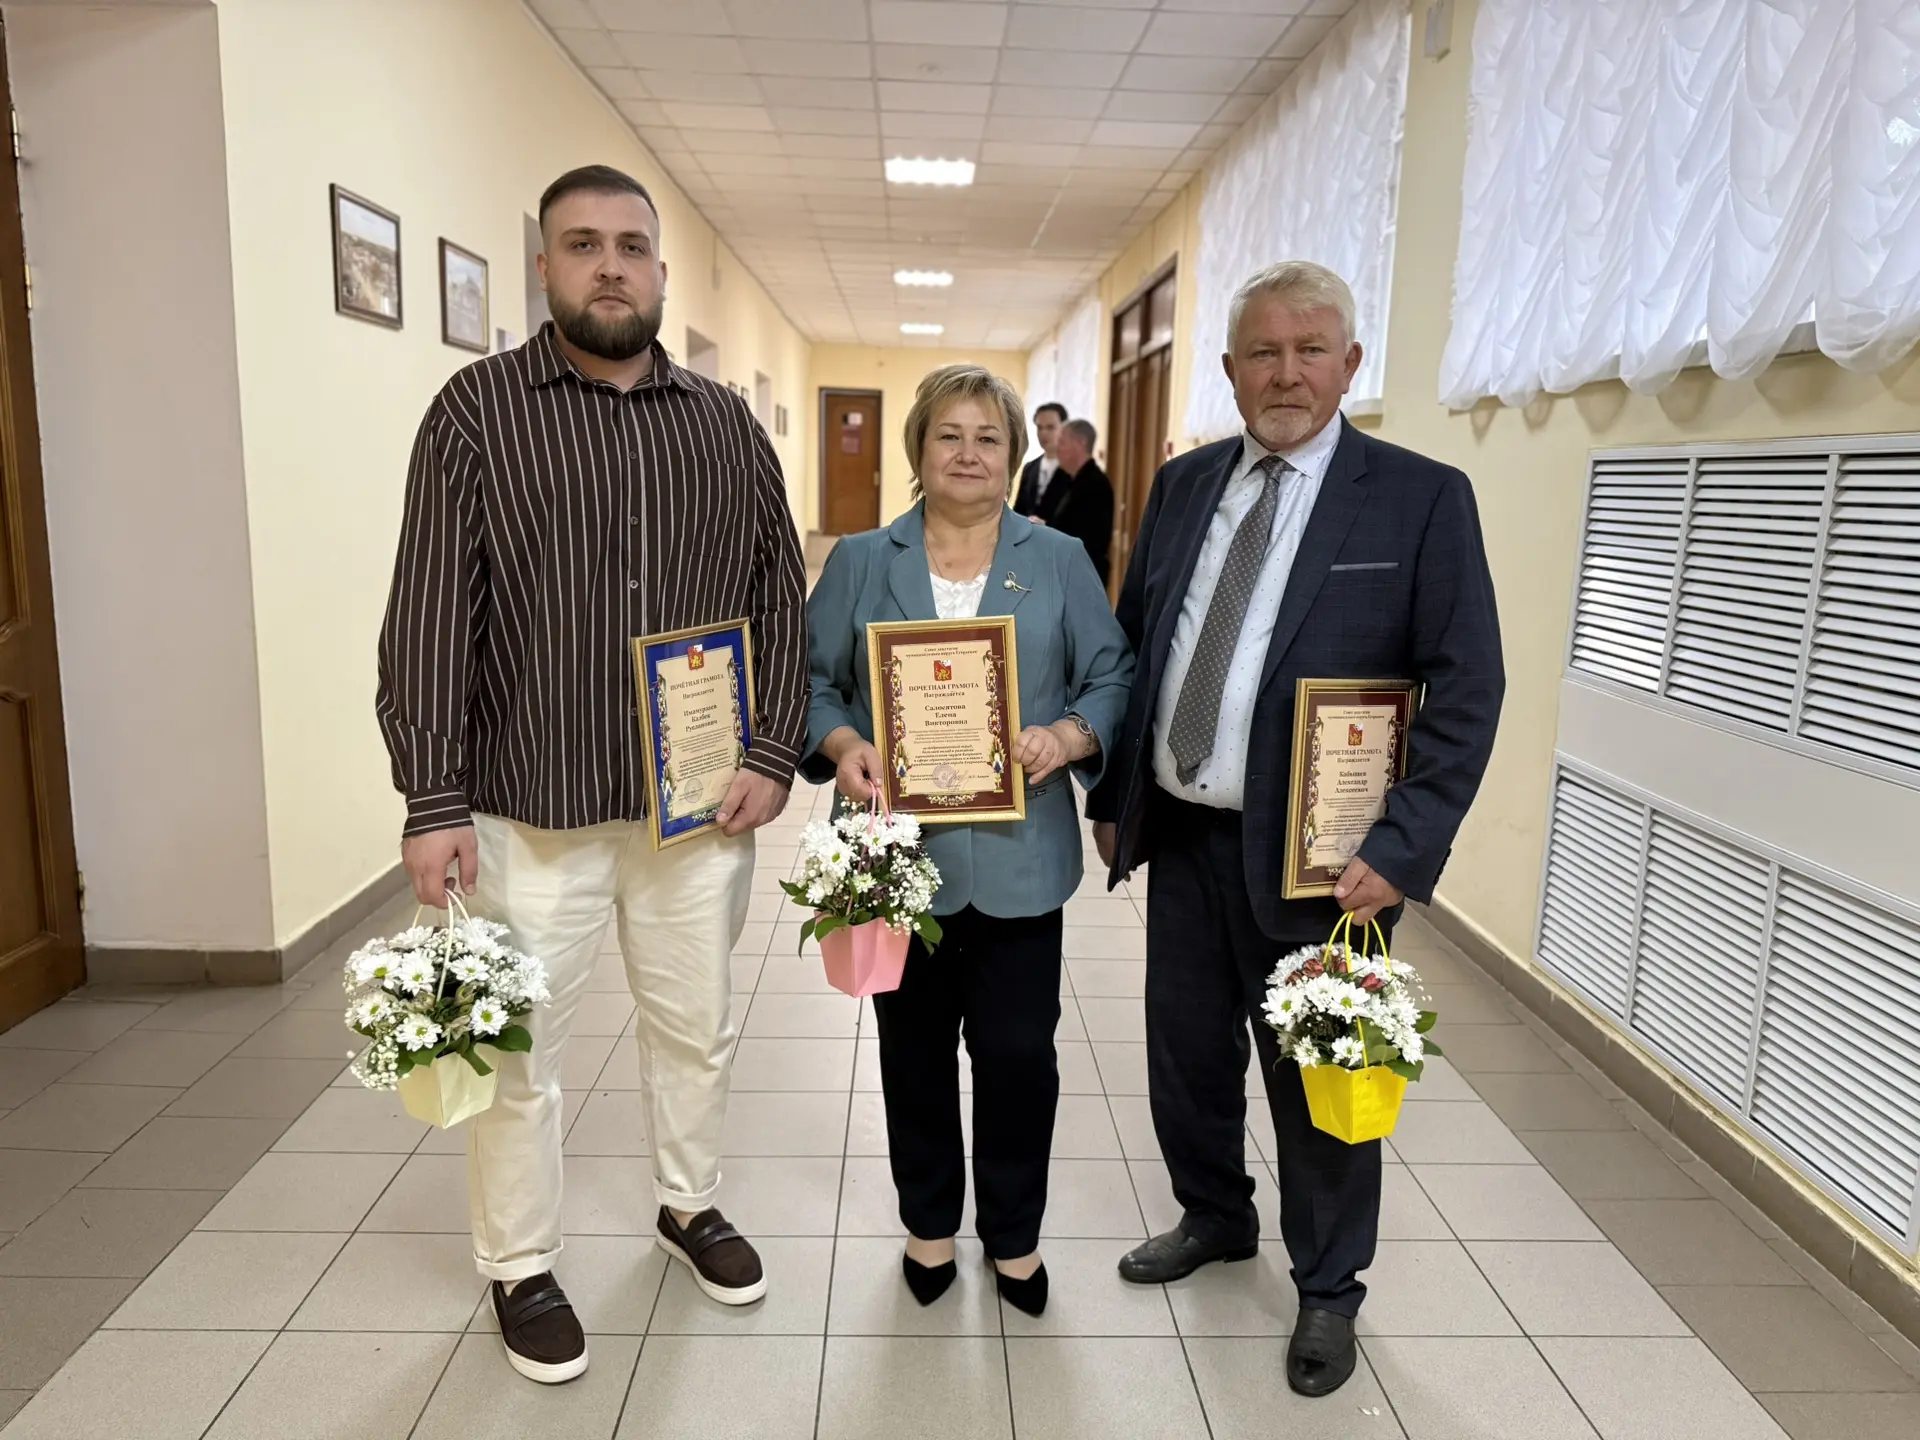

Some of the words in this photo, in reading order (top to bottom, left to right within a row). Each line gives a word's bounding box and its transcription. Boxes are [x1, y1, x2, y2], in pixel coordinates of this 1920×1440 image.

[947, 682, 980, 690] ГРАМОТА
[923, 691, 966, 699] Награждается
[924, 719, 968, 727] Викторовна
